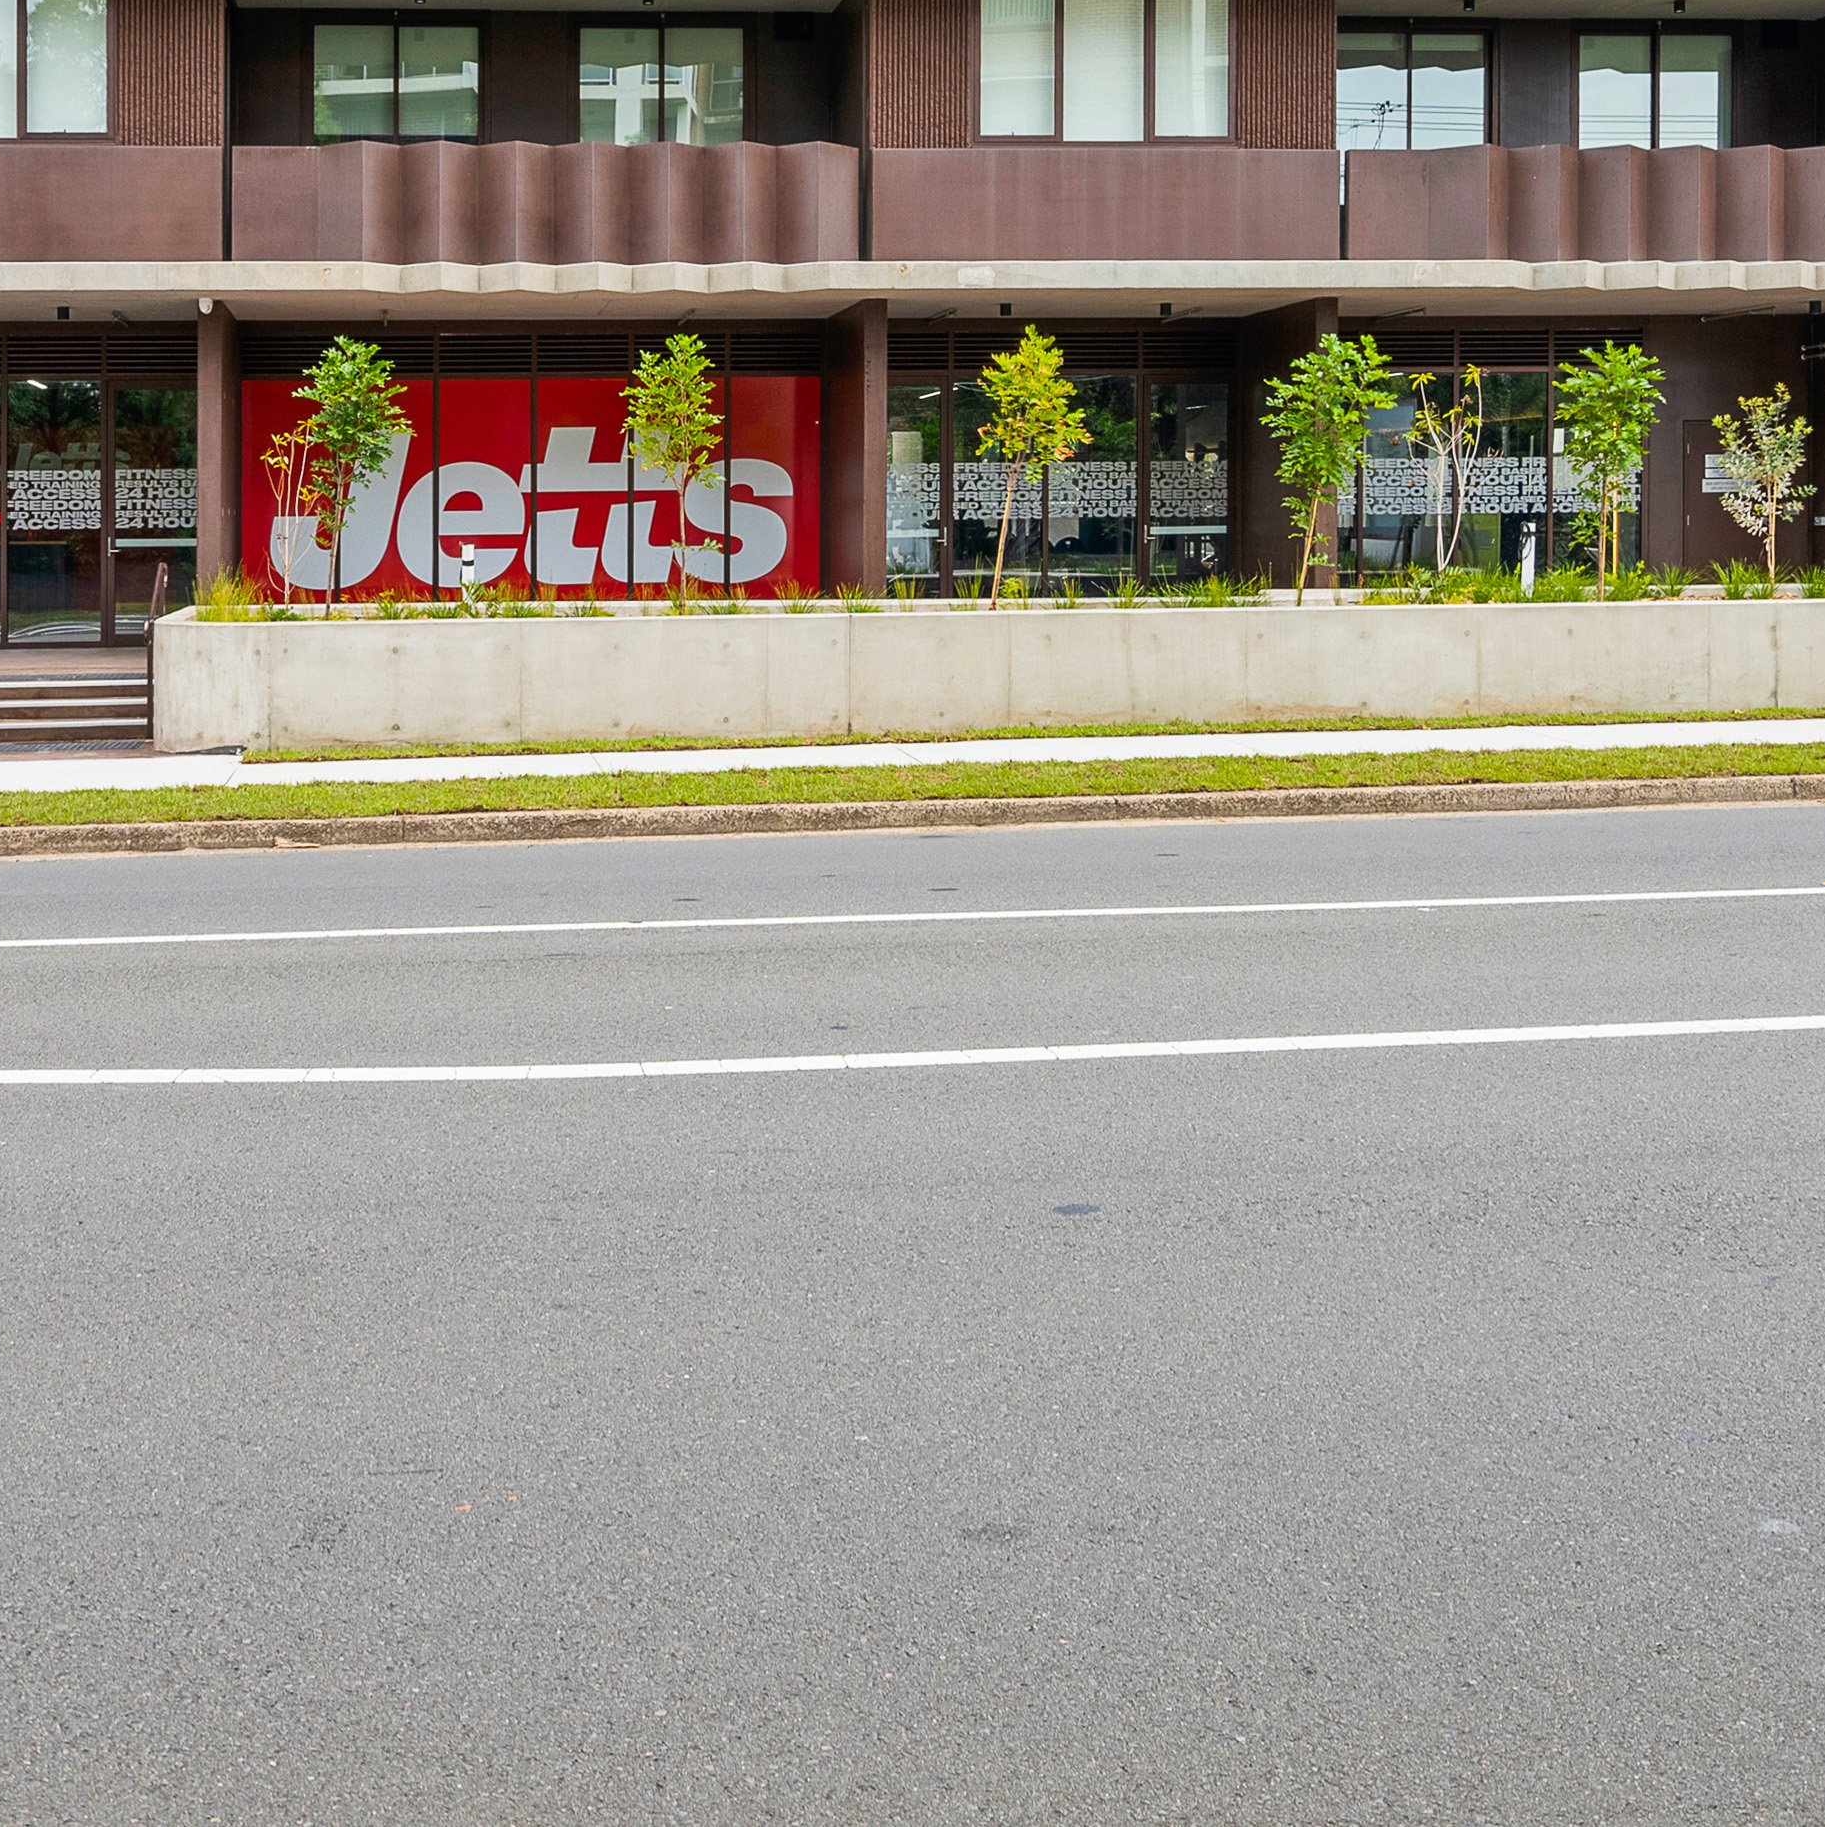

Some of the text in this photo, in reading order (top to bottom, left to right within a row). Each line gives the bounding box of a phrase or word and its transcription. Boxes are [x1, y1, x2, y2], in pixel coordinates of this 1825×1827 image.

[116, 469, 197, 480] FITNESS
[31, 481, 101, 489] TRAINING
[116, 480, 179, 488] RESULTS
[12, 489, 101, 500] ACCESS
[116, 488, 143, 499] 24
[116, 499, 197, 510] FITNESS
[270, 426, 794, 591] Jetts
[32, 511, 101, 519] TRAINING
[116, 510, 179, 518] RESULTS
[1049, 508, 1076, 519] 24
[12, 519, 101, 530] ACCESS
[116, 518, 144, 529] 24
